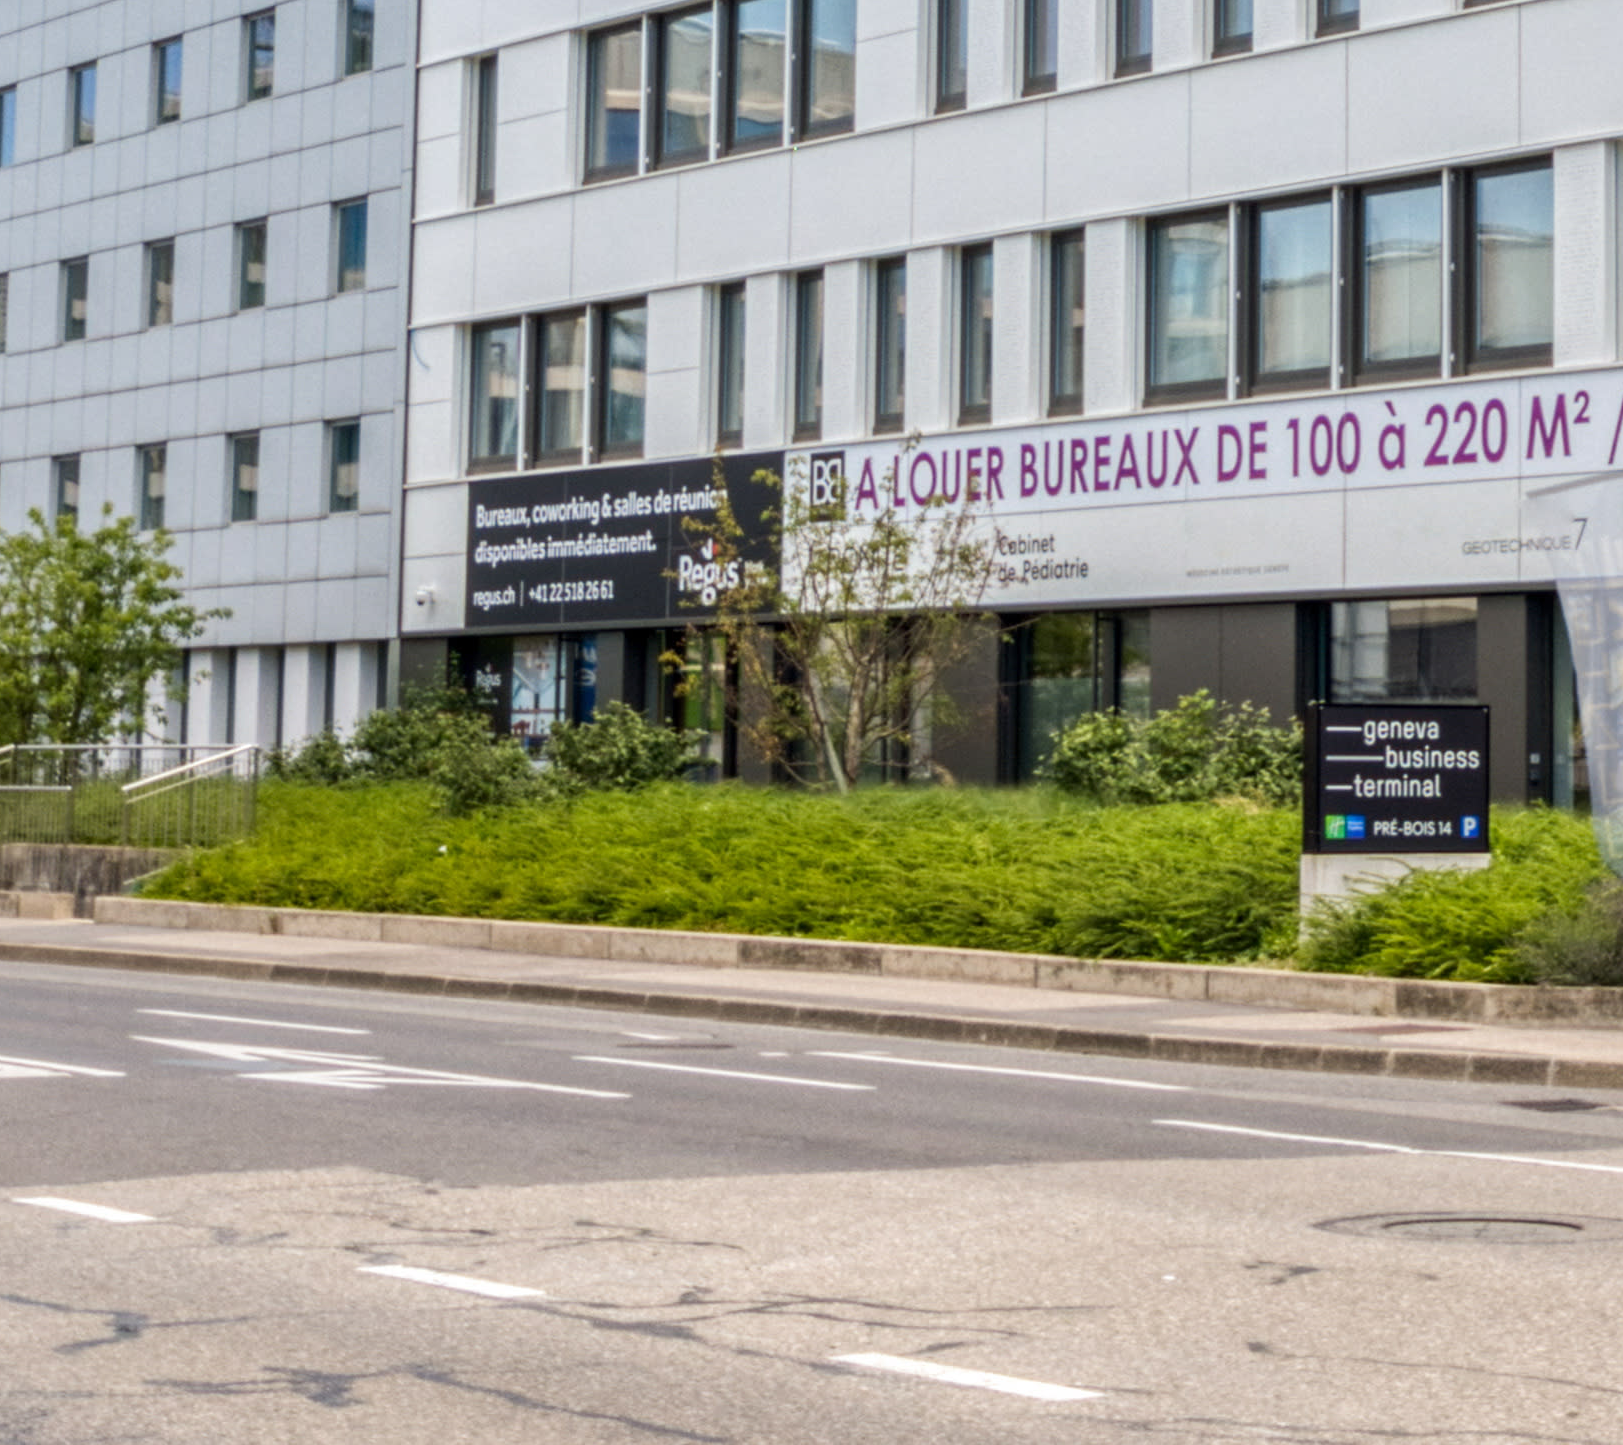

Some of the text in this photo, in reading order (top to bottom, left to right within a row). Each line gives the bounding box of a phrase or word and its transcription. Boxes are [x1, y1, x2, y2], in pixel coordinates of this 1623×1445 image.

[855, 457, 879, 510] A
[893, 447, 1005, 508] LOUER
[1020, 427, 1201, 498] BUREAUX
[1217, 421, 1267, 483] DE
[1286, 412, 1361, 477] 100
[1378, 400, 1406, 470] à
[1423, 398, 1508, 467] 220
[475, 504, 530, 528] Bureaux,
[532, 495, 600, 525] coworking
[601, 493, 613, 519] &
[613, 491, 652, 517] salles
[653, 488, 672, 514] de
[475, 529, 657, 568] disponibles immédiatement.
[998, 534, 1055, 556] Cabinet
[1023, 558, 1089, 582] Pédiatrie
[473, 580, 614, 611] regus.ch +41 22 518 26 61
[1363, 720, 1440, 745] geneva
[1385, 745, 1480, 769] business
[1353, 774, 1442, 797] terminal
[1373, 818, 1436, 837] PRÉ-BOIS
[1438, 821, 1452, 837] 14
